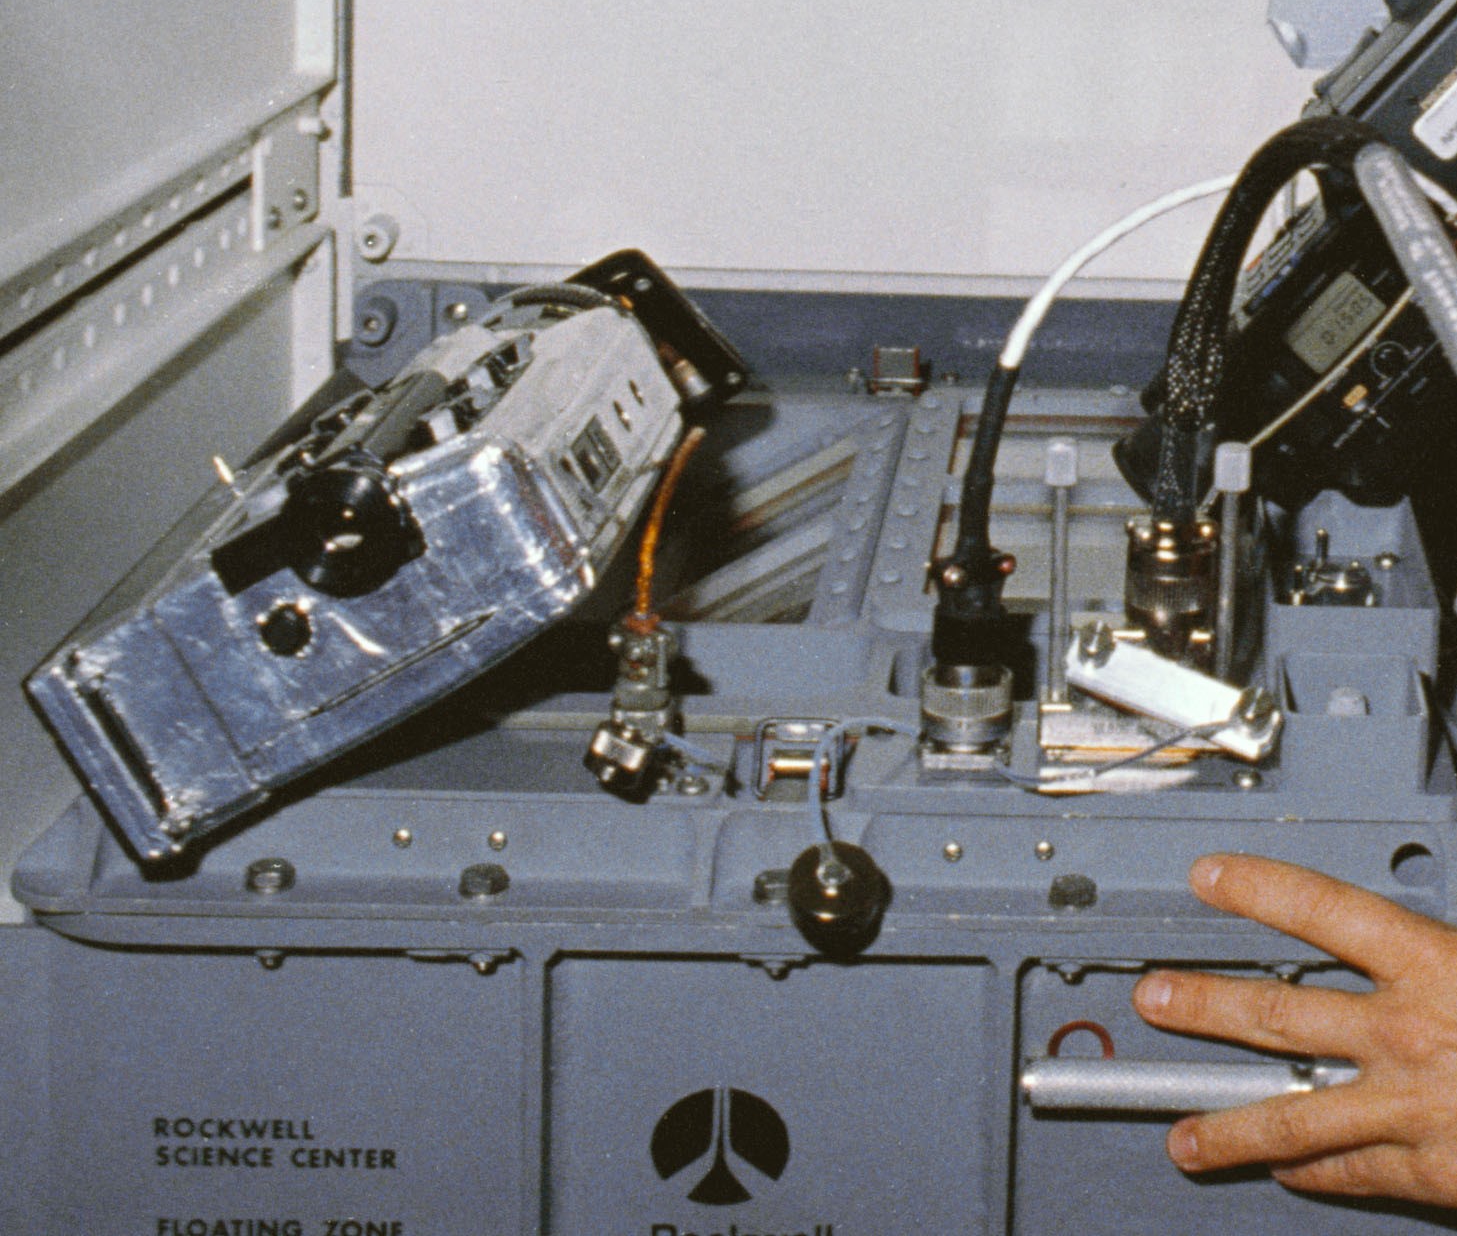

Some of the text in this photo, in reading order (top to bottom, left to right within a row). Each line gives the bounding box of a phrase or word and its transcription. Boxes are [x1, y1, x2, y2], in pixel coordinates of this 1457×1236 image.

[153, 1117, 315, 1140] ROCKWELL
[155, 1146, 397, 1169] SCIENCE CENTER
[157, 1218, 402, 1236] FLOATING ZONE
